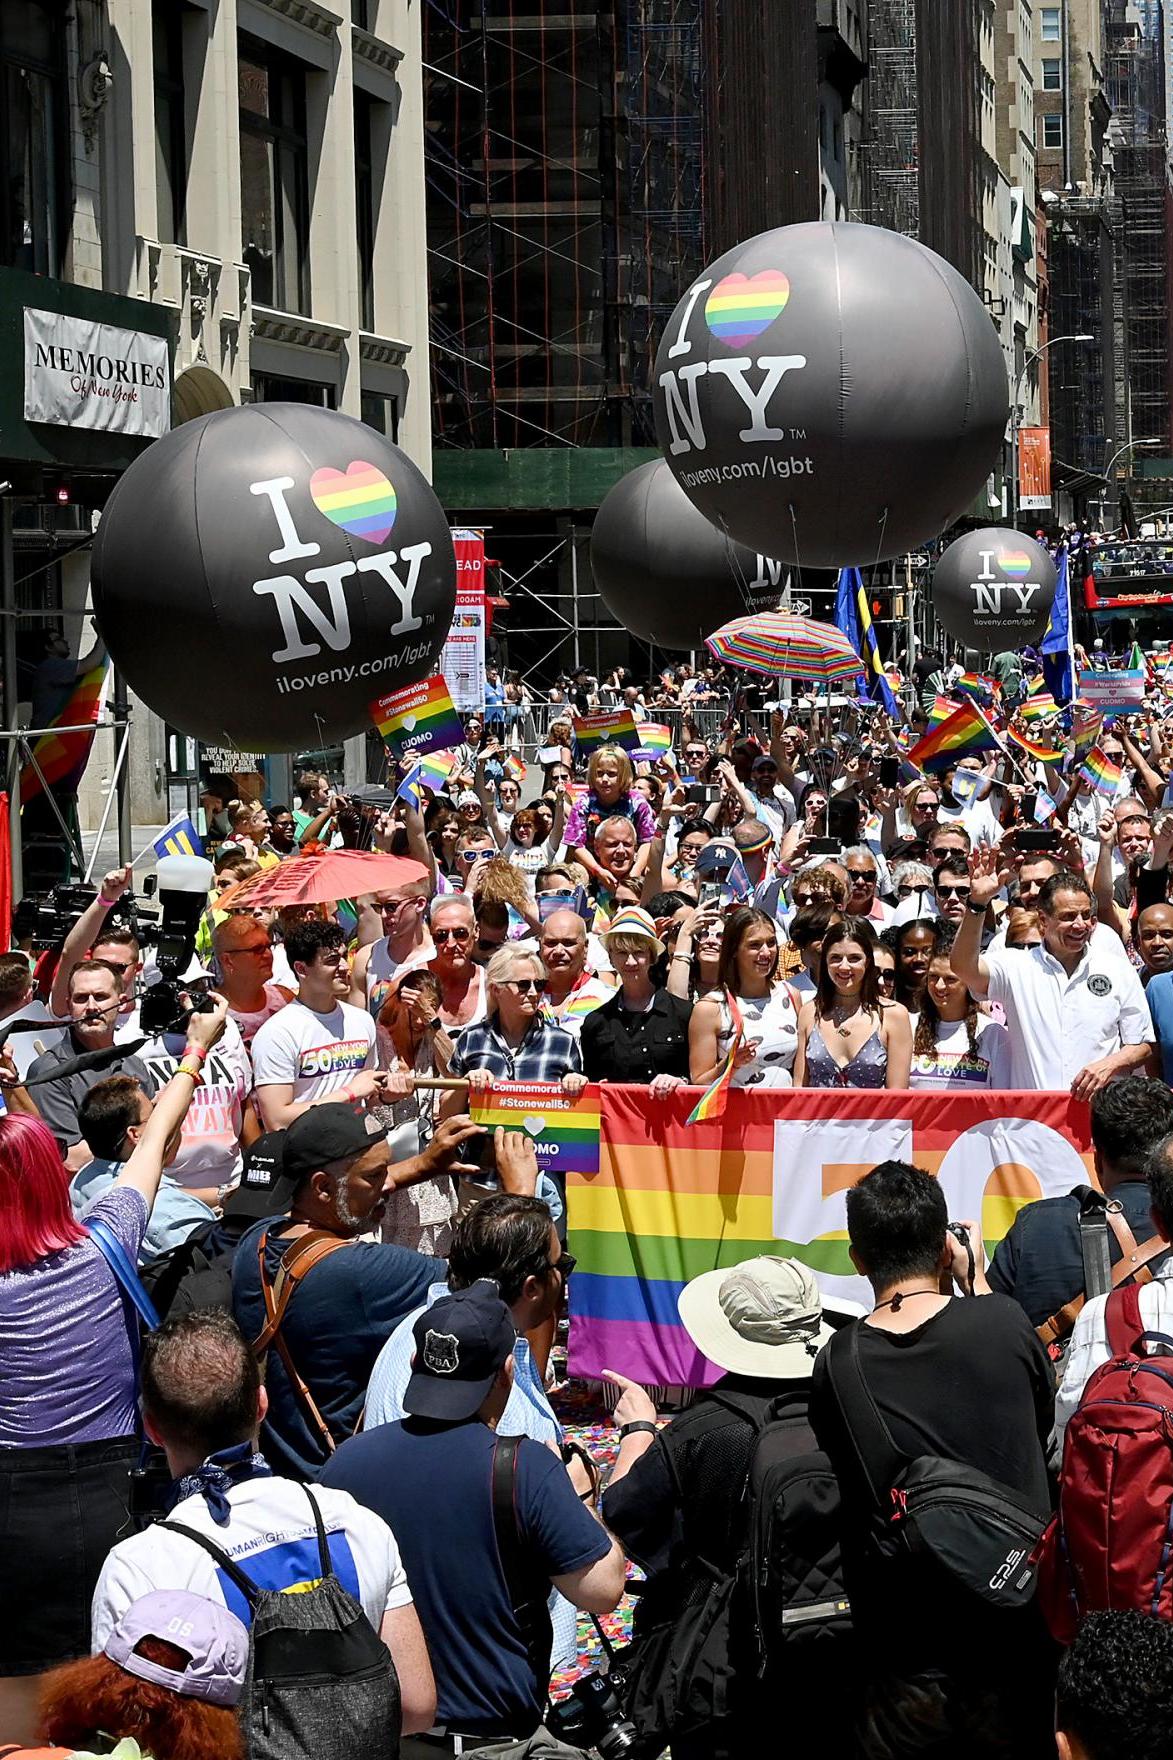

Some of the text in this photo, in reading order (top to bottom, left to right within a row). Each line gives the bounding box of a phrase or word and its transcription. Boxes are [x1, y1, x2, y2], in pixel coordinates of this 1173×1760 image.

[669, 278, 712, 358] I
[33, 342, 166, 390] MEMORIES
[70, 375, 89, 401] Of
[112, 383, 138, 403] York
[659, 354, 807, 456] NY
[680, 456, 814, 488] iloveny.com/lgbt
[250, 476, 321, 564] I
[456, 559, 481, 571] EAD
[978, 550, 996, 579] I
[252, 541, 432, 663] NY
[456, 597, 482, 605] :00AM
[970, 583, 1041, 614] NY
[276, 640, 433, 694] iloveny.com/lgbt
[378, 682, 429, 707] Commemorating
[401, 731, 433, 750] CUOMO
[209, 766, 233, 774] VIOLENT
[301, 1048, 332, 1076] 50
[332, 1060, 357, 1070] LOVE
[937, 1067, 967, 1078] LOVE
[492, 1082, 564, 1094] Commemorat
[499, 1097, 570, 1109] #Stonewall50
[532, 1143, 560, 1155] OMO
[773, 1117, 1102, 1316] 50
[428, 1355, 451, 1368] PBA
